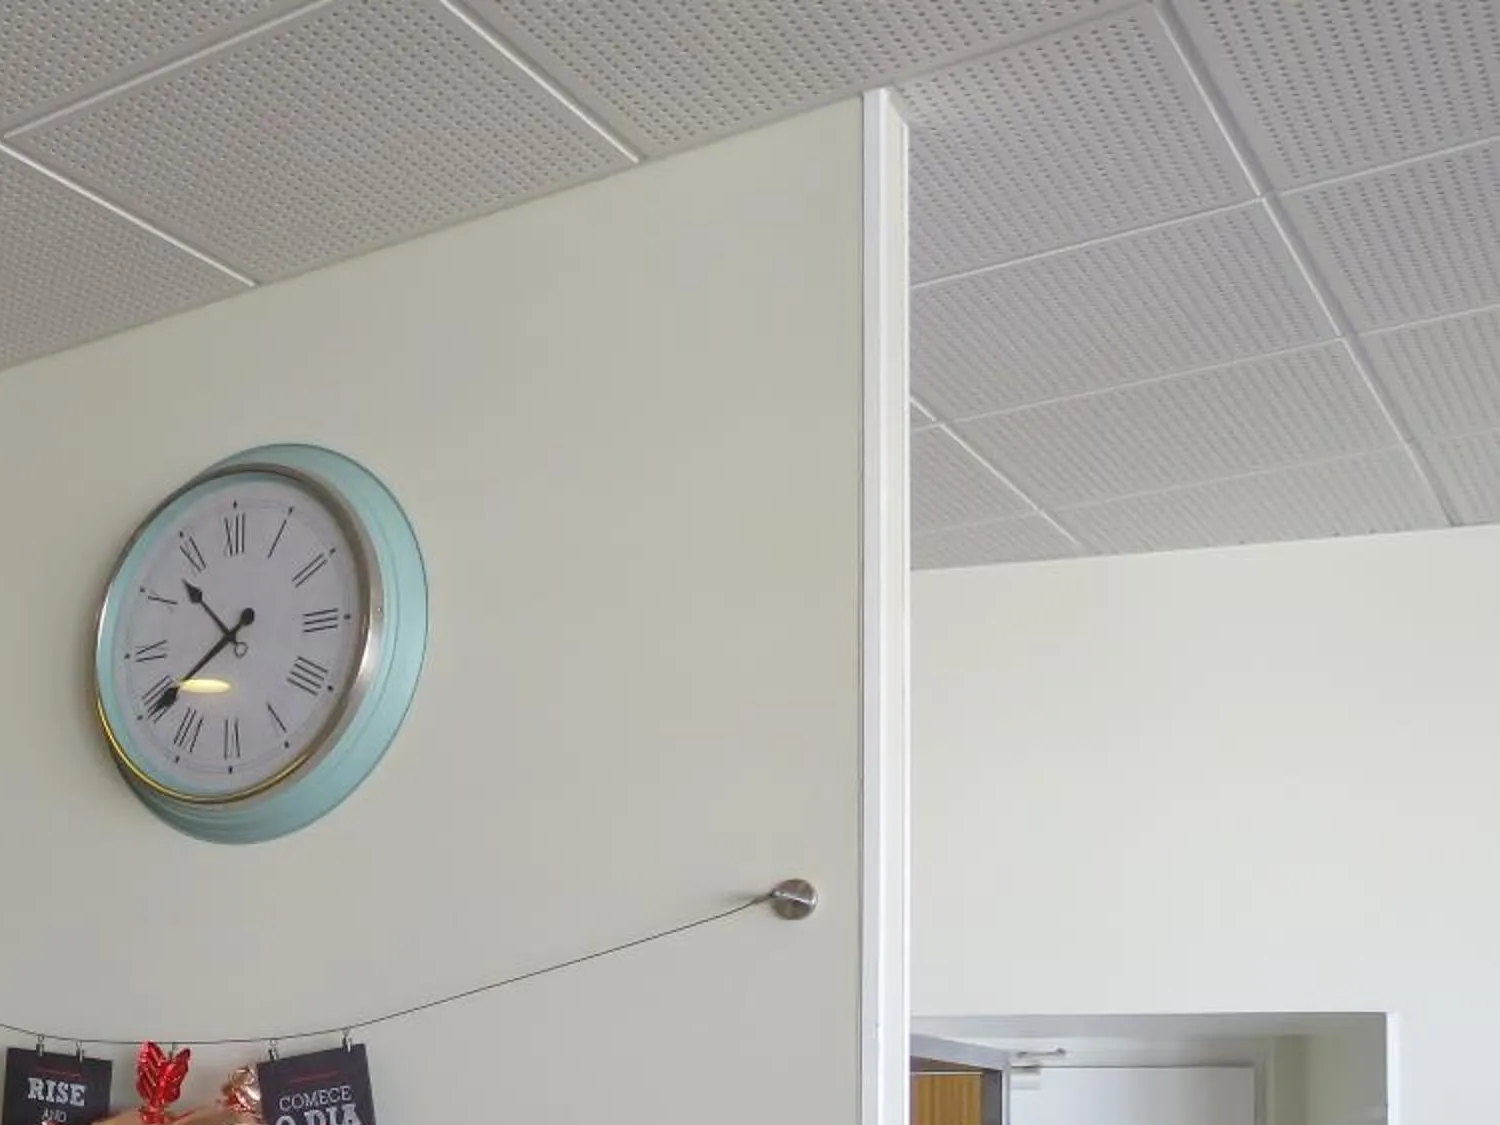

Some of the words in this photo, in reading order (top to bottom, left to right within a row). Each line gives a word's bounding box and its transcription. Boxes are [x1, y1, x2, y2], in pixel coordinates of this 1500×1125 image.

[26, 1077, 86, 1107] RISE
[279, 1085, 353, 1112] COMECE
[41, 1107, 68, 1123] AND
